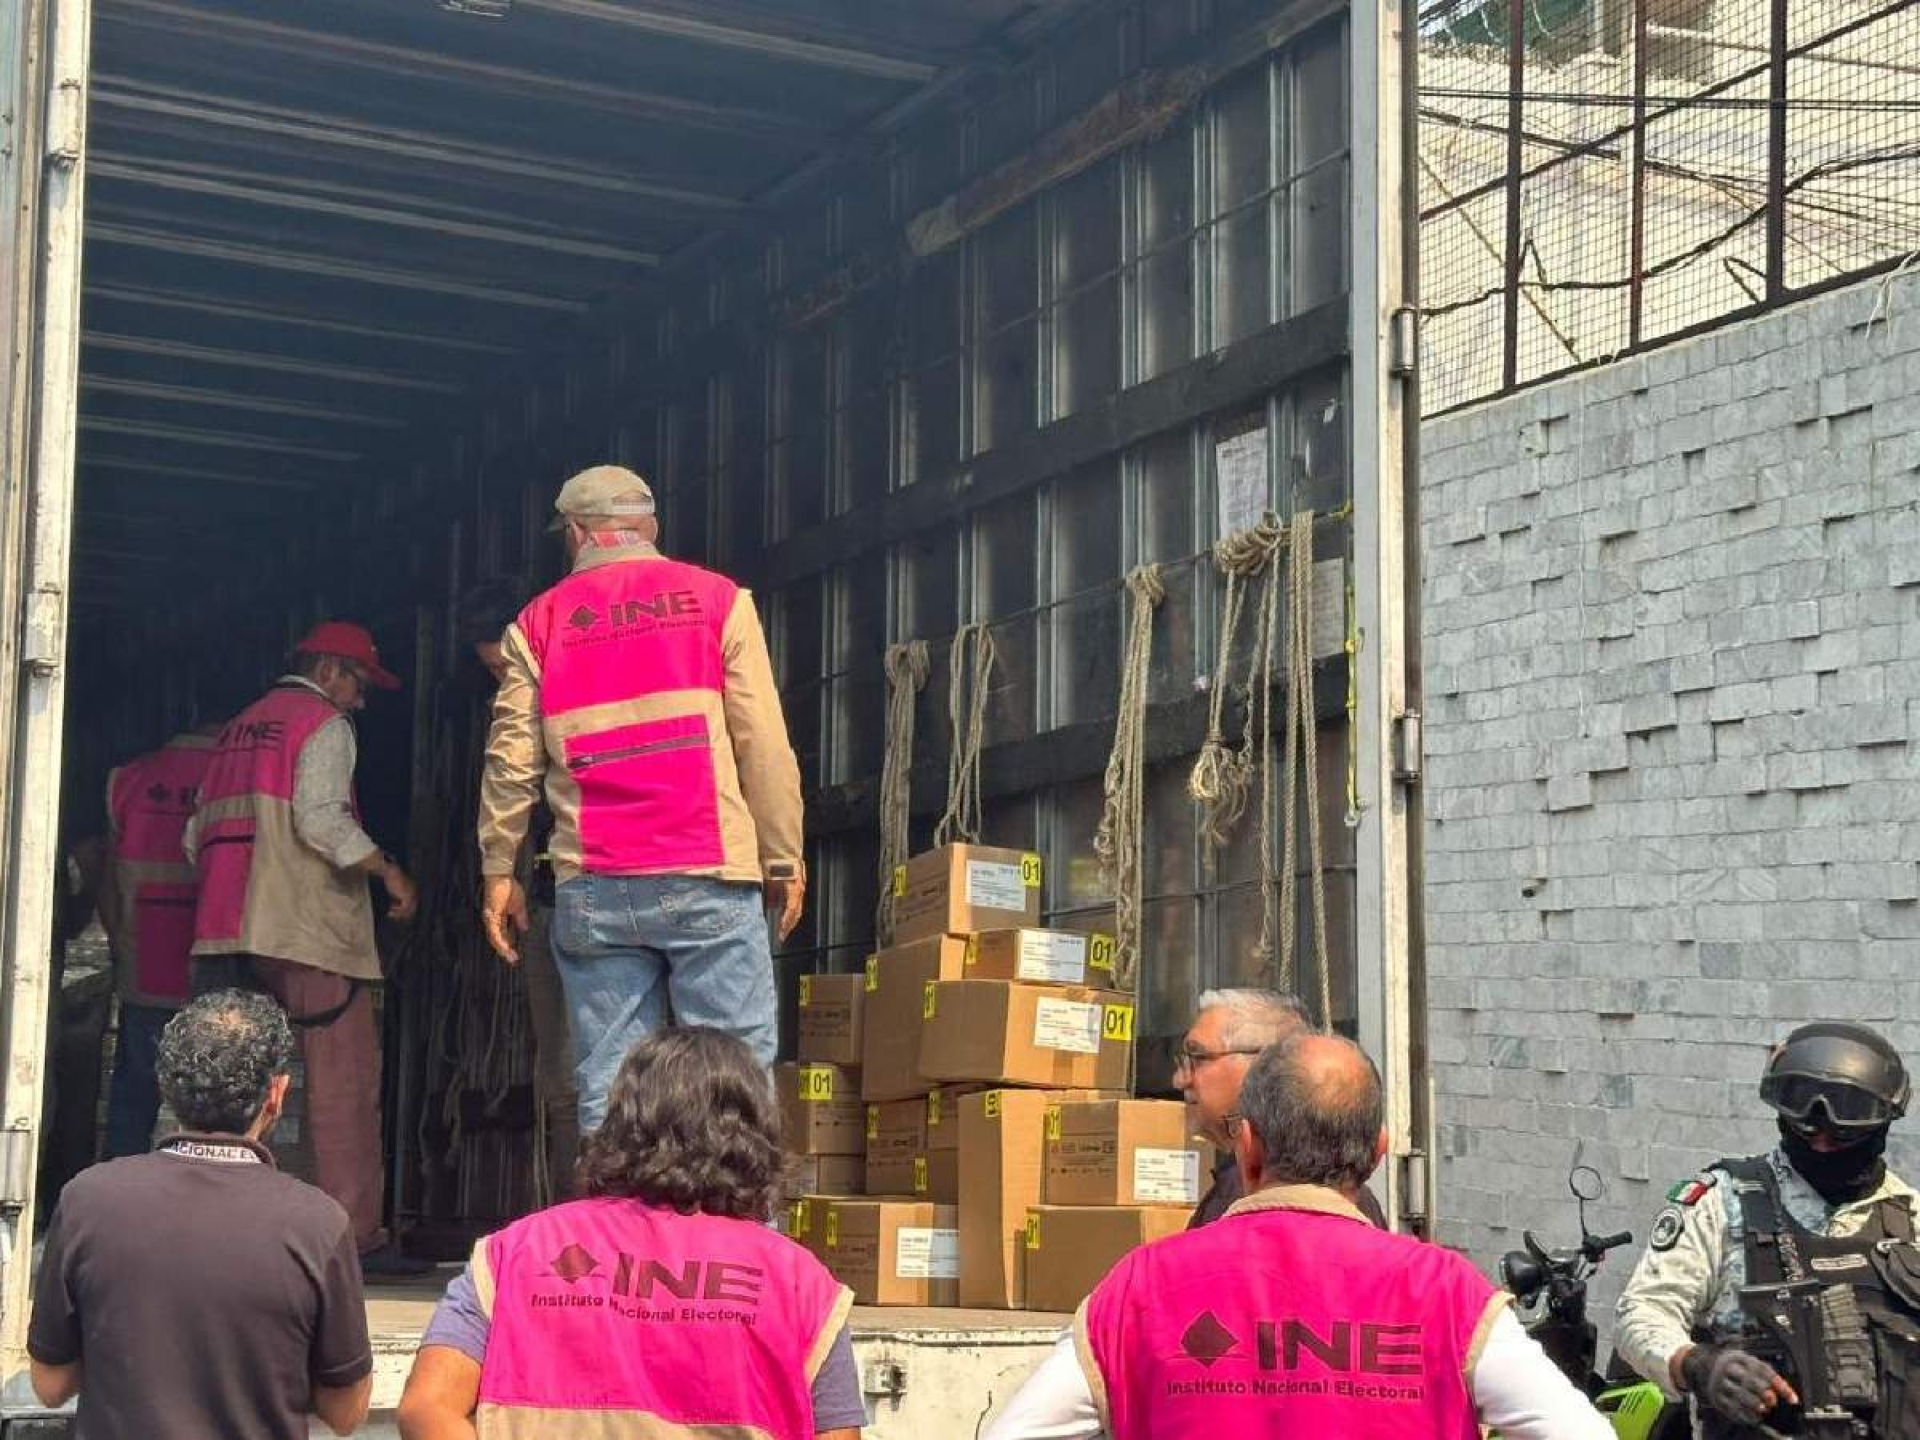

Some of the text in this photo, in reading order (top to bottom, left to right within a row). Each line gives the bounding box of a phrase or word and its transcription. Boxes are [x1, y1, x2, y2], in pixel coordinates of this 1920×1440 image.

[611, 590, 702, 627] INE
[234, 720, 285, 745] INE
[1023, 860, 1039, 881] 01
[1092, 940, 1111, 962] 01
[1106, 1010, 1126, 1033] 01
[814, 1073, 831, 1094] 01
[612, 1252, 764, 1306] INE
[531, 1293, 604, 1308] Instituto
[681, 1307, 756, 1326] Electoral
[1256, 1320, 1422, 1375] INE
[1167, 1379, 1425, 1400] Instituto Nacional Electoral
